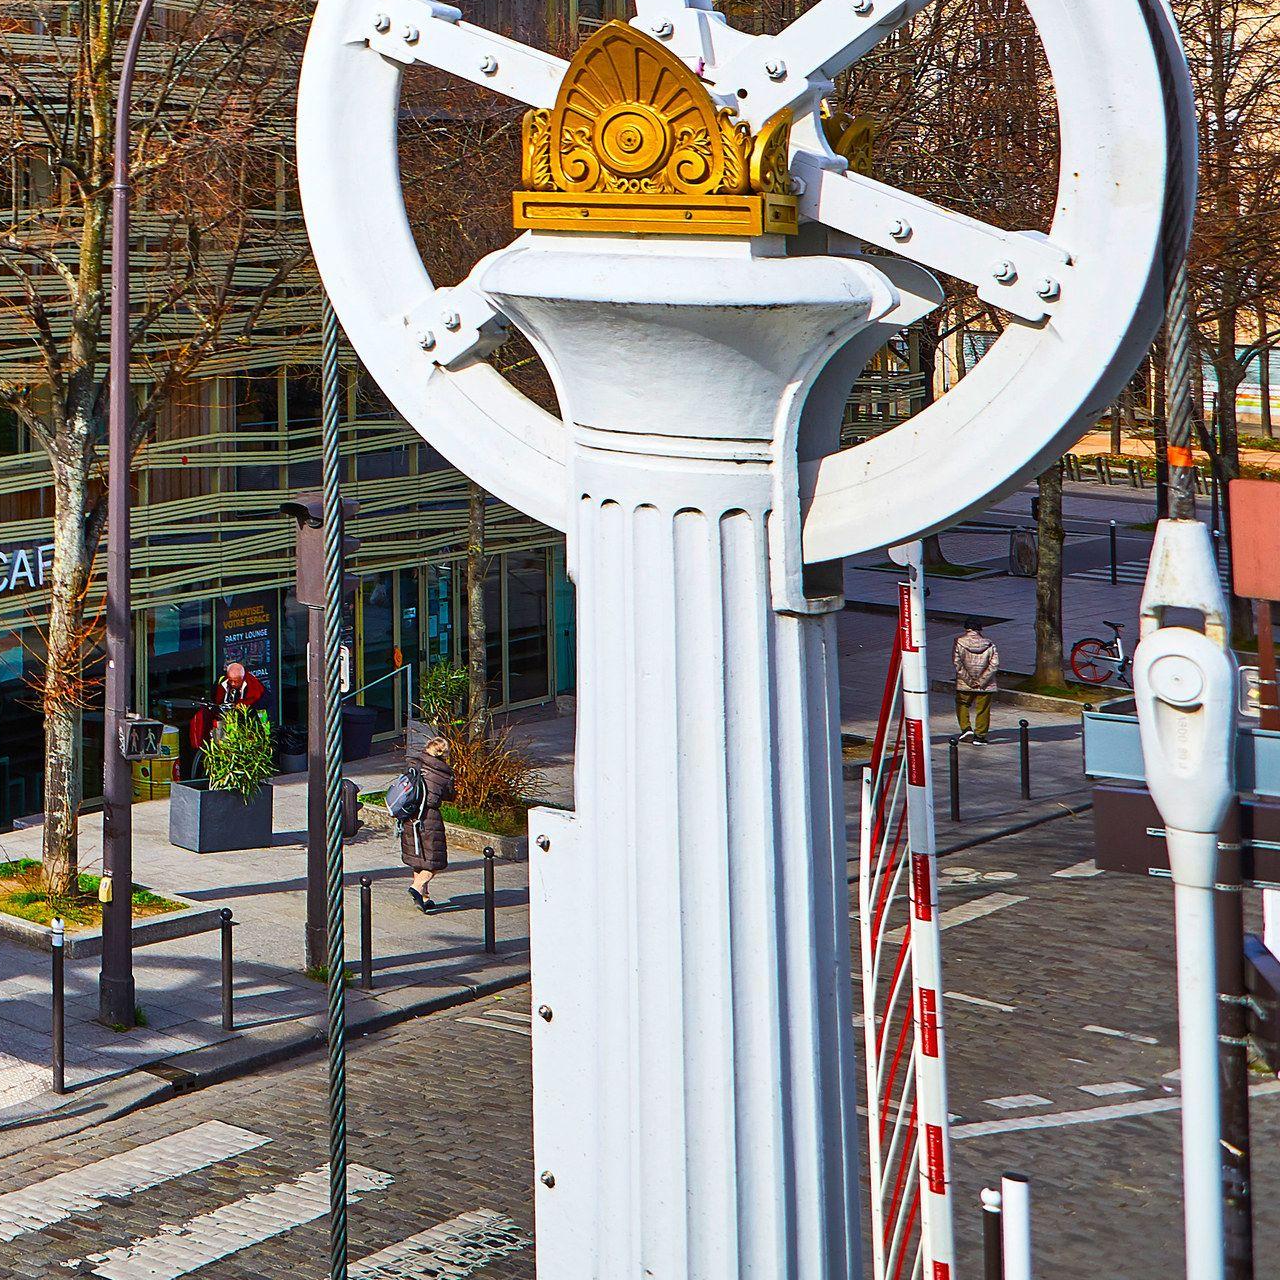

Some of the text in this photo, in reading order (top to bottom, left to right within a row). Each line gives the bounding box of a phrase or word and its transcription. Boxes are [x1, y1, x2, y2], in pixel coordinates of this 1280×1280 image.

[223, 613, 270, 629] VOTRE ESPACE
[225, 628, 268, 642] PARTY LOUNGE
